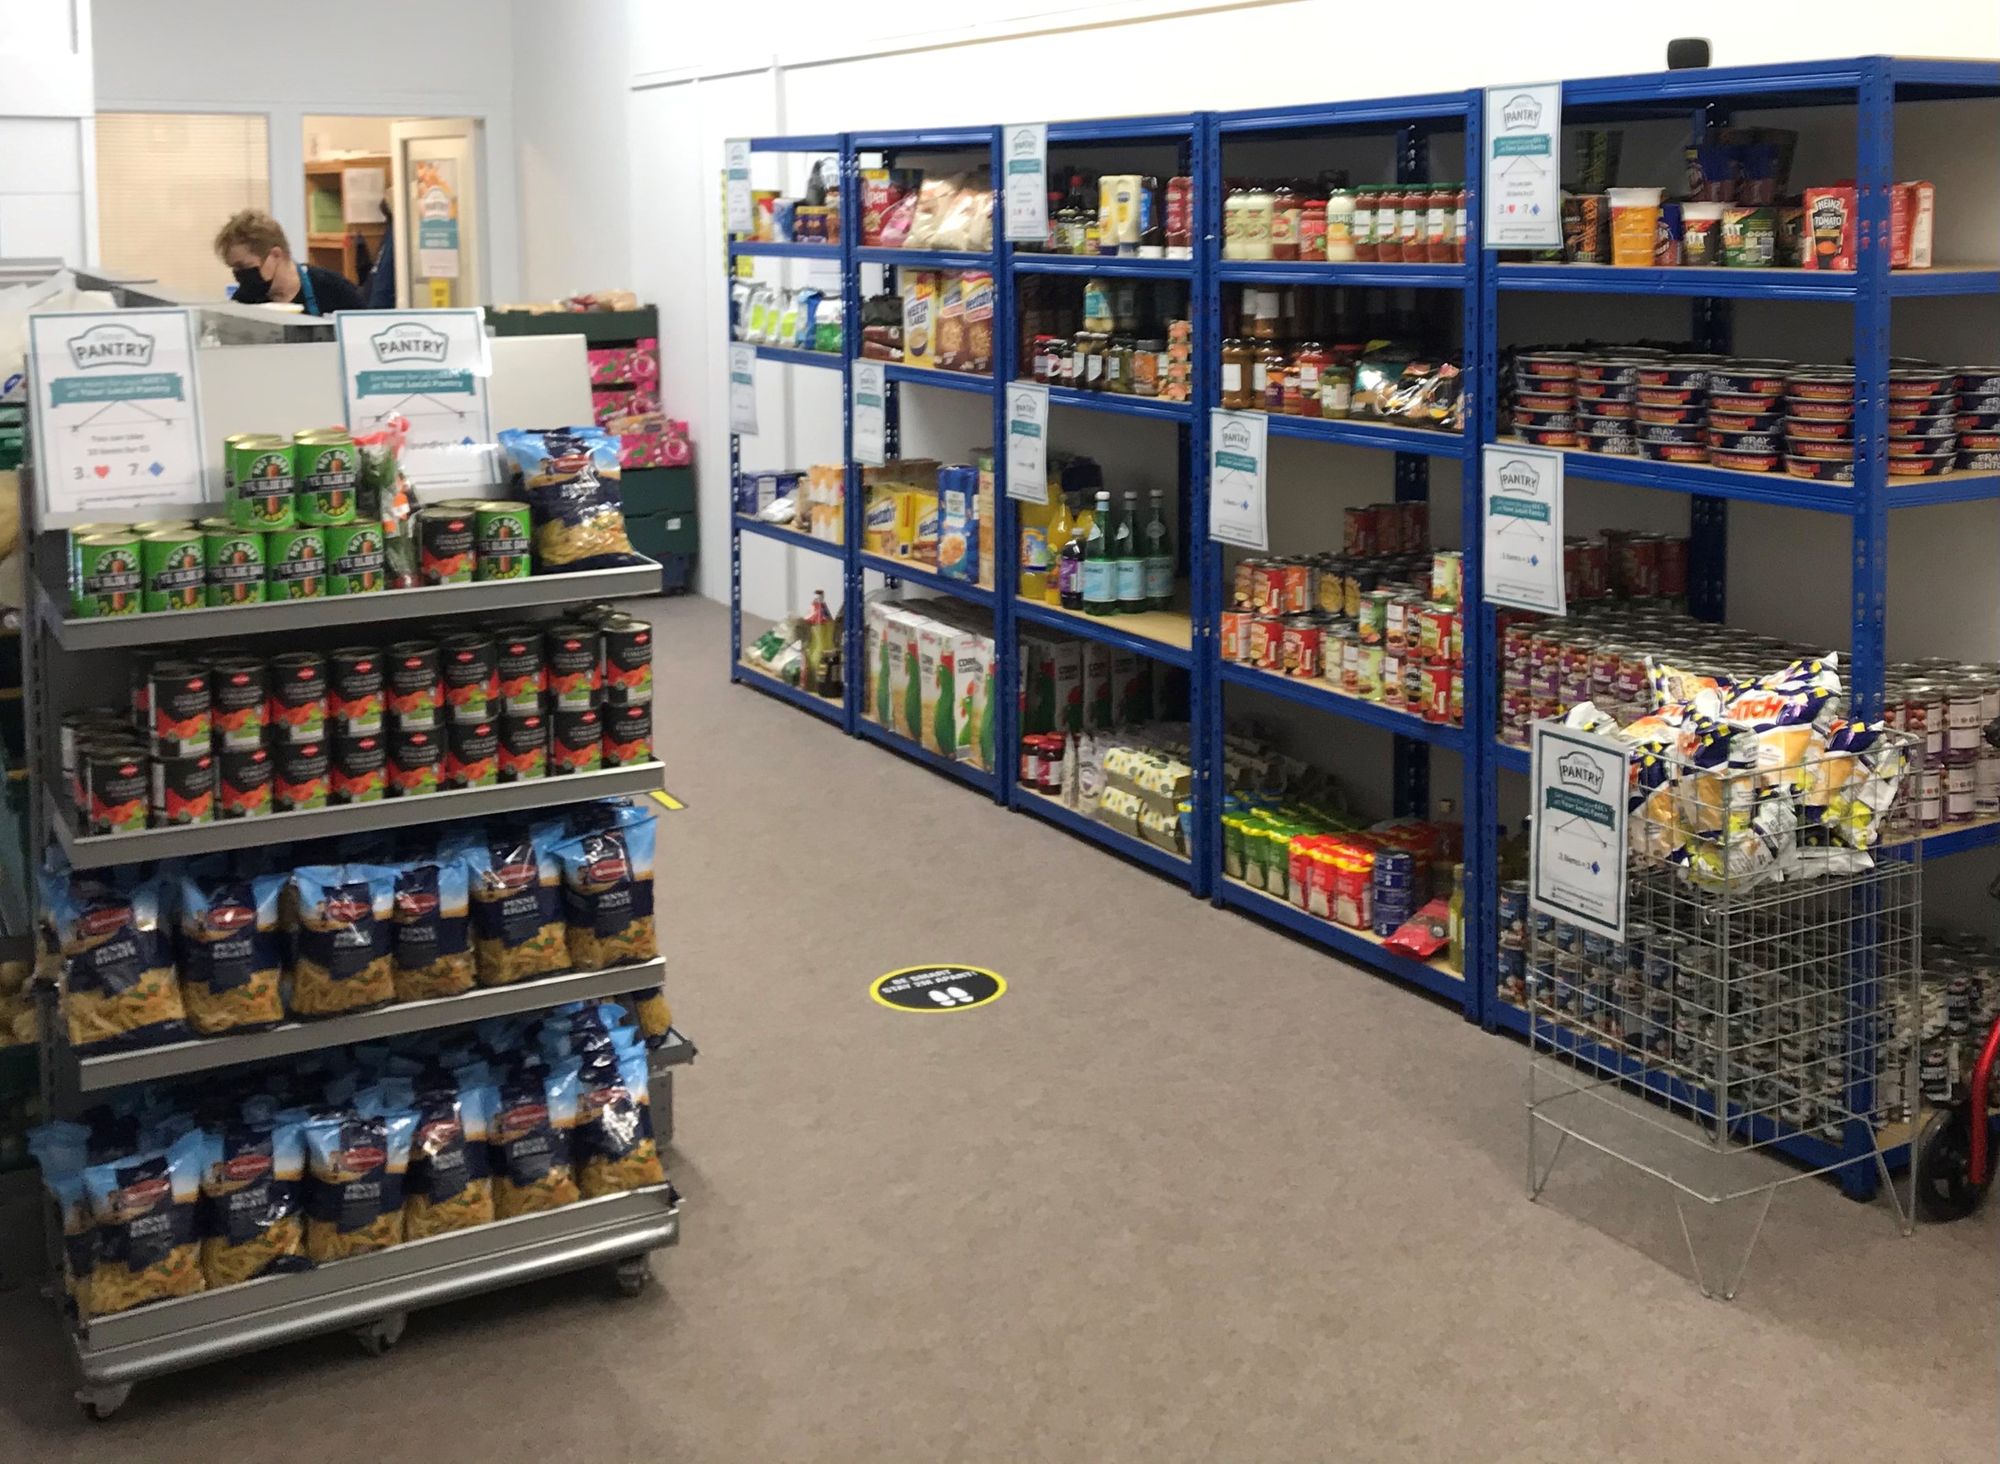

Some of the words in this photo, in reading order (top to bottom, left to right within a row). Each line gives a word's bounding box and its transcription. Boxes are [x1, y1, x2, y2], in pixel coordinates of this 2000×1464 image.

[1505, 108, 1539, 123] PANTRY
[1817, 199, 1840, 210] HEINZ
[1814, 217, 1842, 227] TOMATO
[76, 342, 151, 360] PANTRY
[379, 340, 444, 354] PANTRY
[1224, 432, 1249, 444] PANTRY
[73, 466, 84, 480] 3
[128, 463, 140, 476] 7
[1502, 473, 1537, 489] PANTRY
[1562, 764, 1602, 786] PANTRY
[881, 983, 912, 994] STAY
